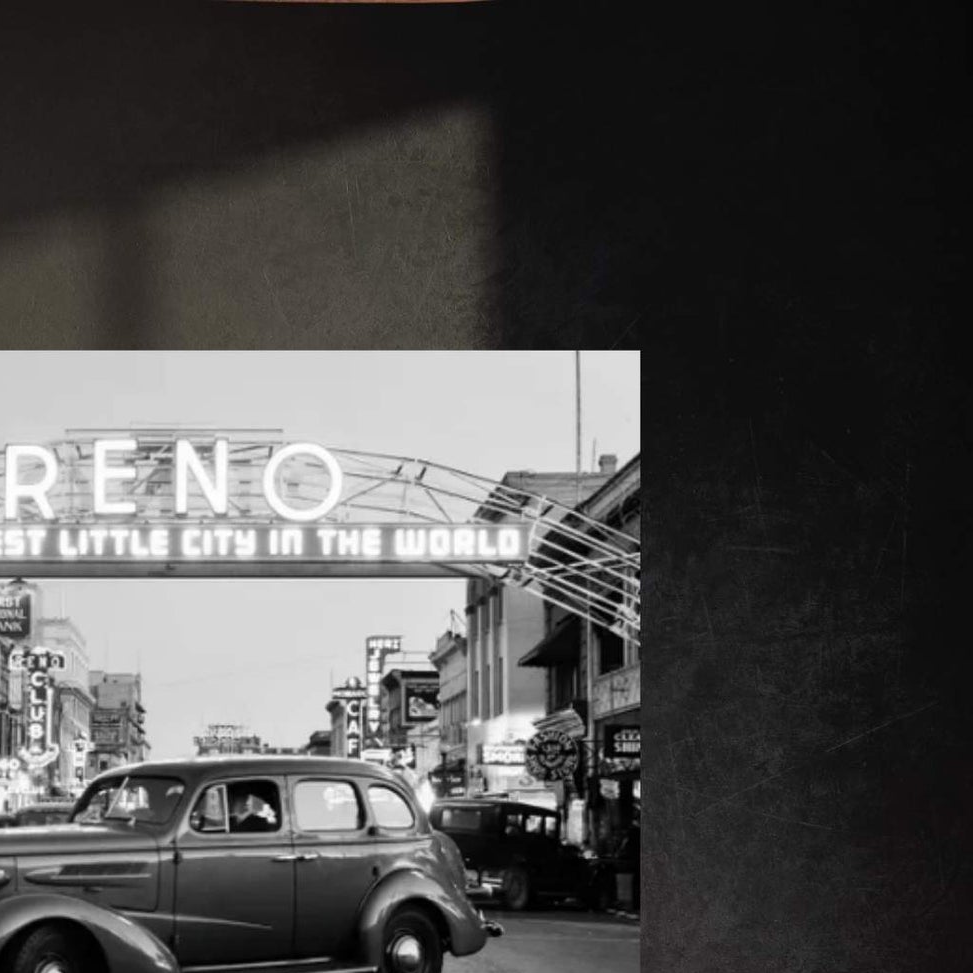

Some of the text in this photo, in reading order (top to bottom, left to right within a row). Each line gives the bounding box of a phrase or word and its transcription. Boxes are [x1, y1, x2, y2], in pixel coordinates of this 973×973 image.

[4, 437, 343, 520] RENO
[58, 528, 170, 558] LITTLE
[181, 528, 257, 558] CITY
[268, 528, 304, 557] IN
[316, 528, 383, 557] THE
[394, 528, 521, 558] WORLD
[29, 671, 48, 739] CLUB
[346, 700, 360, 754] CAF
